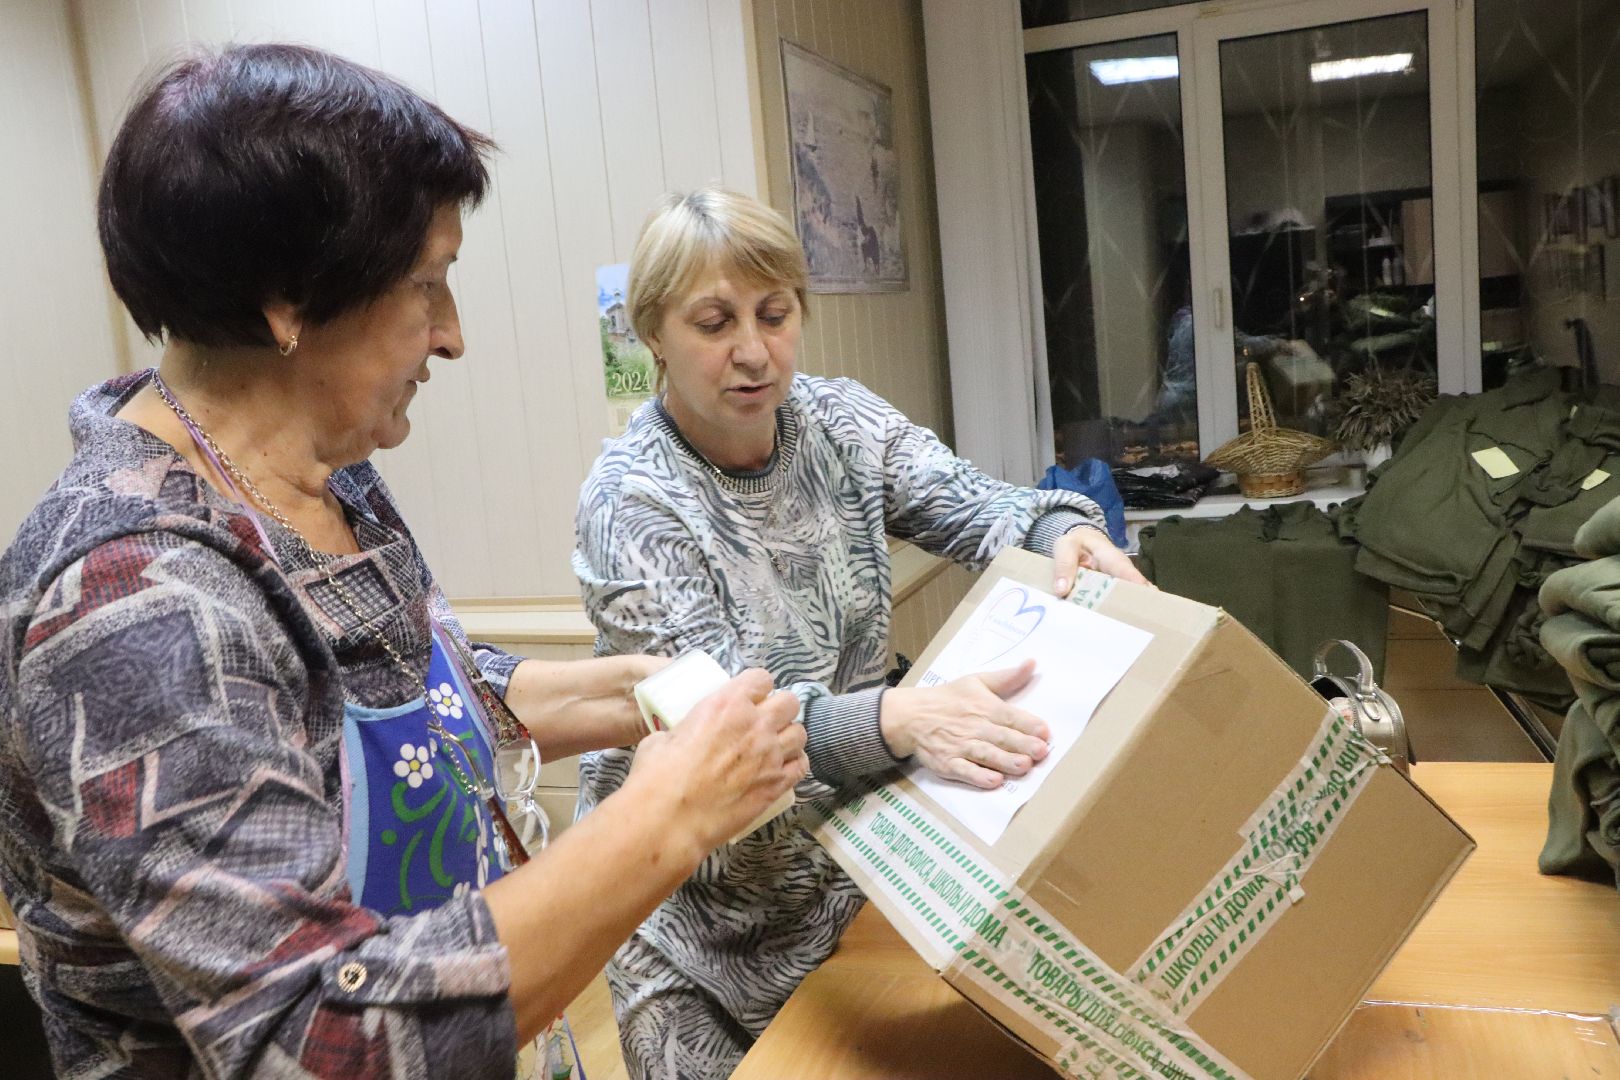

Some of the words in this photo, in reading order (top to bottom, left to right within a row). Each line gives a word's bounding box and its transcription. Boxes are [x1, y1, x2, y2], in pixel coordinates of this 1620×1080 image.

[611, 371, 652, 393] 2024
[868, 811, 902, 846] ТОВАРЫ
[885, 833, 915, 861] ДЛЯ
[900, 846, 941, 884] ОФИСА,
[926, 868, 969, 909] ШКОЛЫ
[955, 896, 975, 916] И
[957, 900, 1011, 950] ДОМА
[1159, 924, 1220, 989] ШКОЛЫ
[1210, 912, 1230, 932] И
[1223, 873, 1270, 923] ДОМА
[1026, 950, 1089, 1011] ТОВАРЫ
